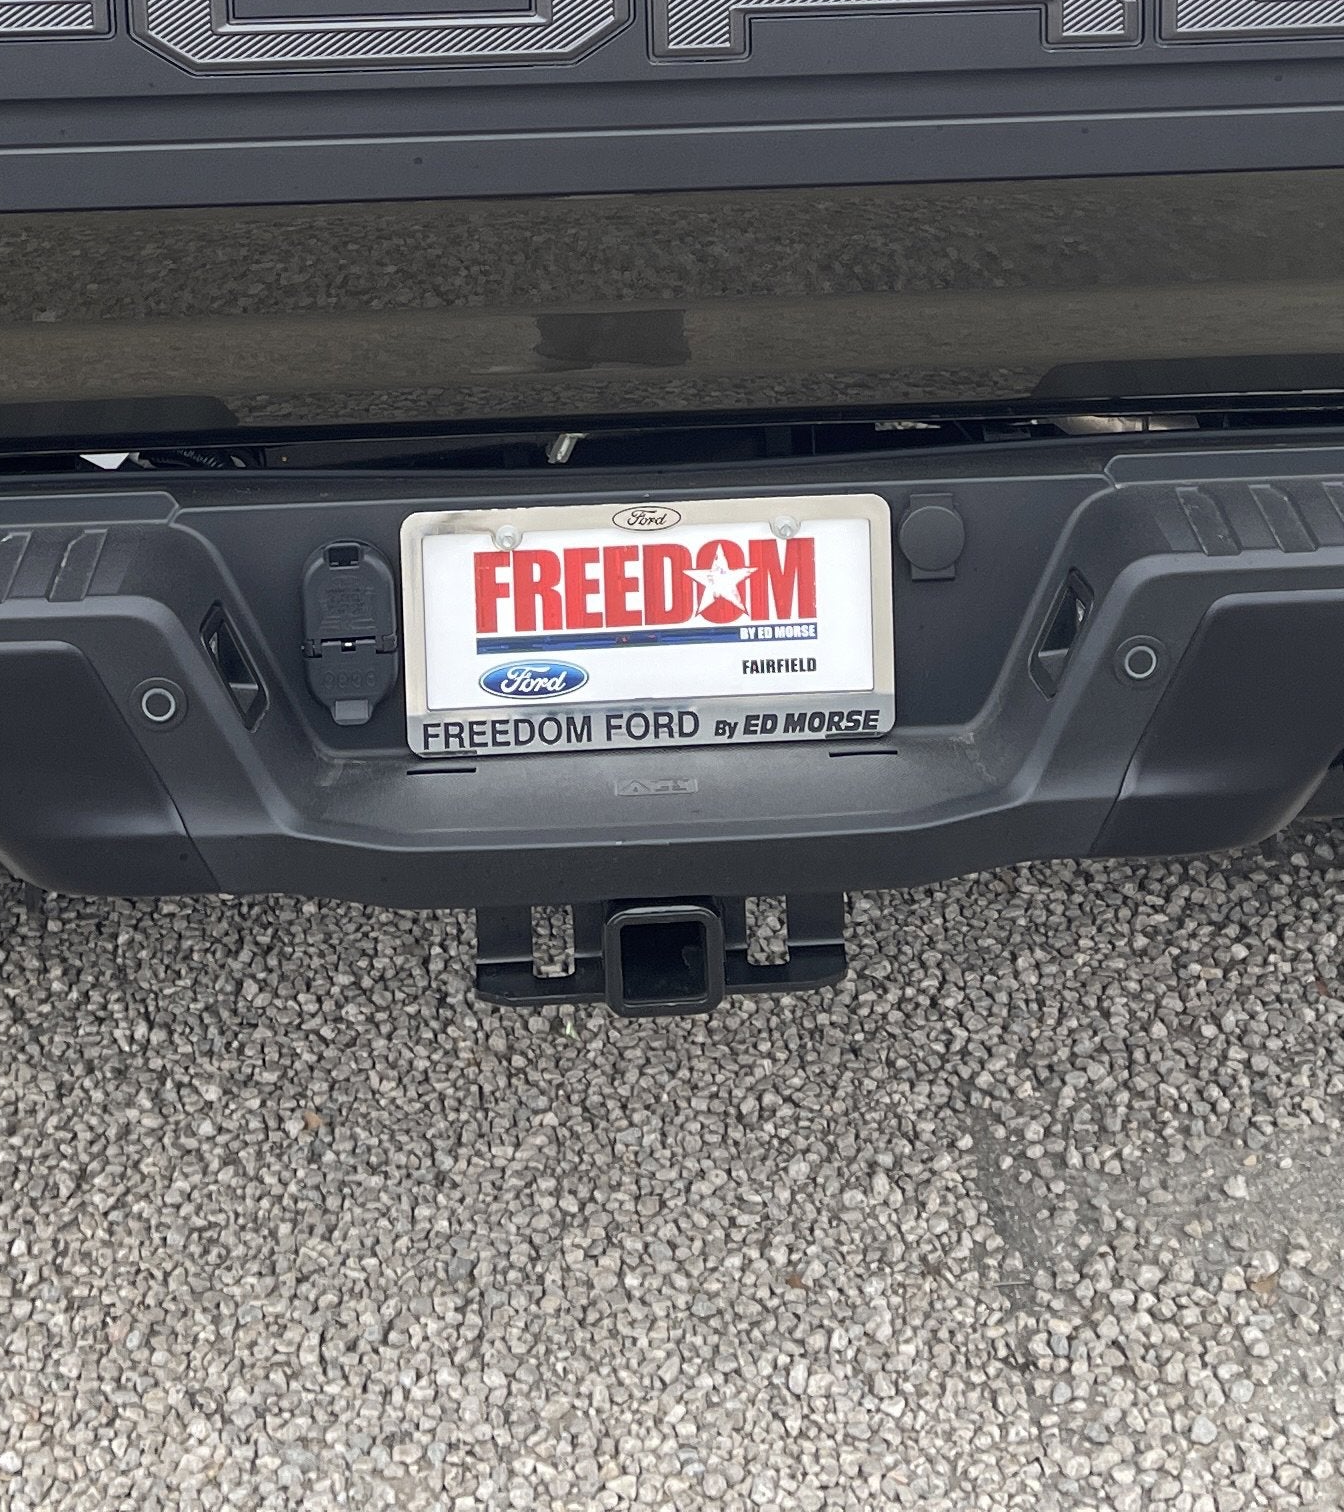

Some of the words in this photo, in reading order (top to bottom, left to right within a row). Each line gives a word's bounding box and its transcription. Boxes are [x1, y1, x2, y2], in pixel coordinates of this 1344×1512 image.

[627, 509, 667, 526] Ford
[474, 538, 817, 633] FREEDOM
[740, 627, 755, 640] BY
[757, 626, 773, 639] ED
[774, 624, 816, 639] MORSE
[742, 657, 817, 675] FAIRFIELD
[500, 666, 567, 693] Ford
[423, 715, 592, 750] FREEDOM
[605, 711, 700, 742] FORD
[714, 719, 737, 739] By
[743, 713, 778, 735] ED
[782, 709, 880, 734] MORSE
